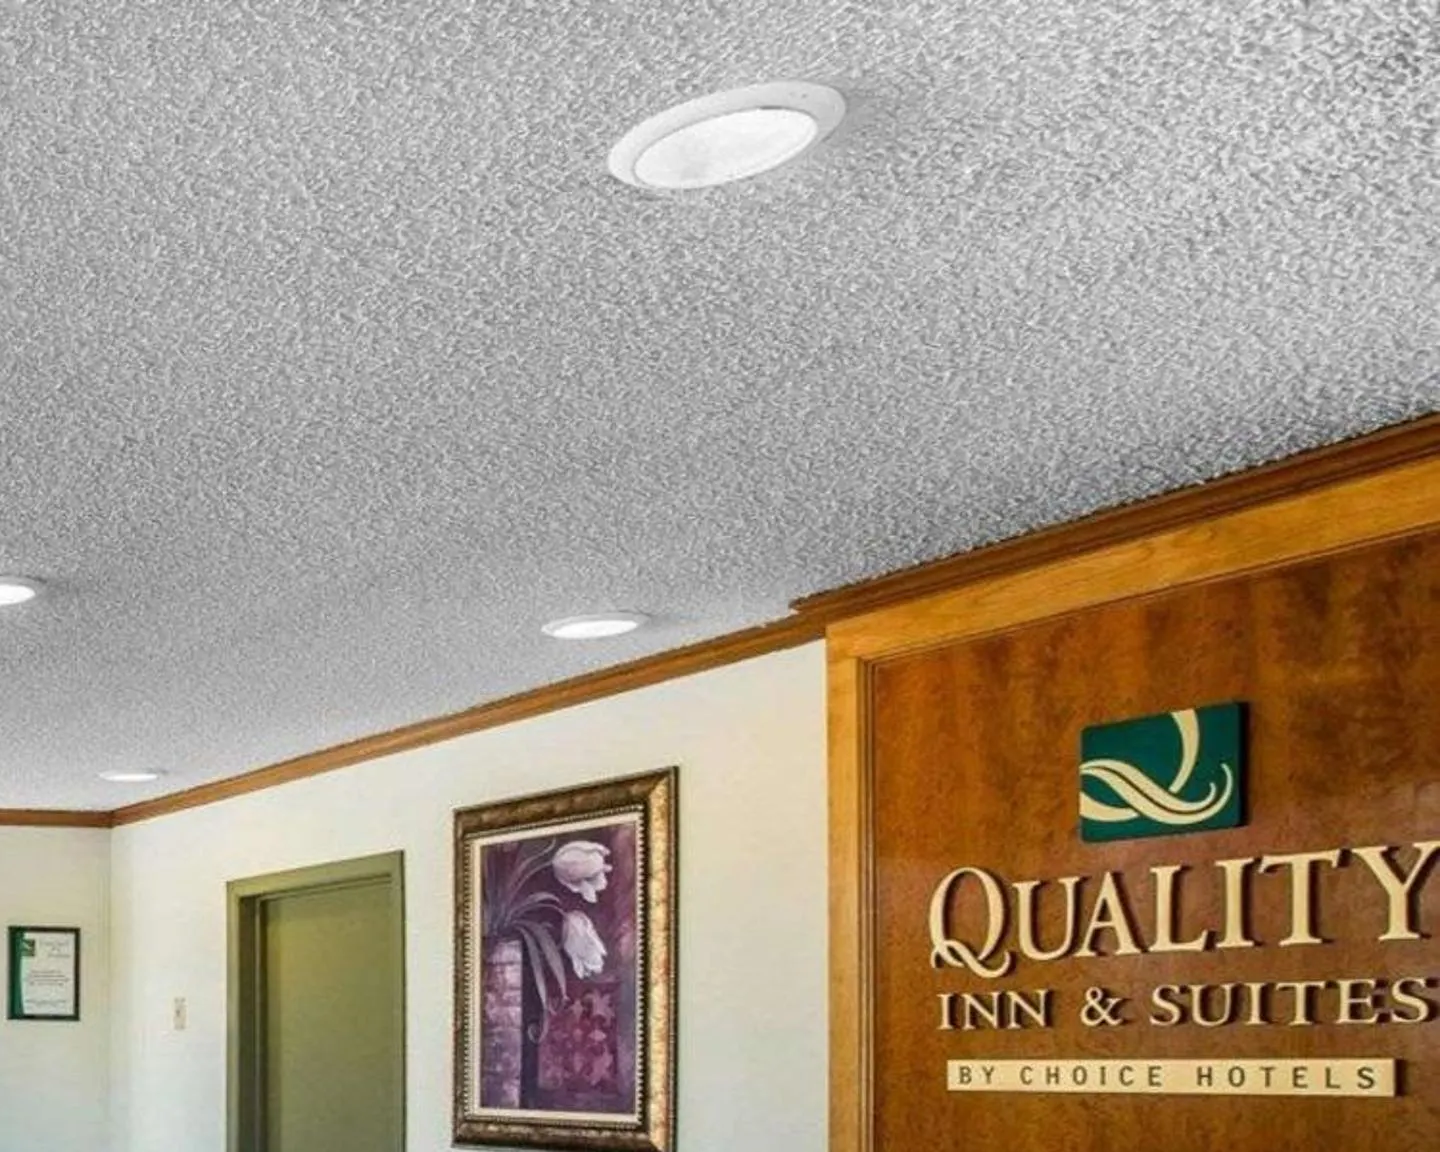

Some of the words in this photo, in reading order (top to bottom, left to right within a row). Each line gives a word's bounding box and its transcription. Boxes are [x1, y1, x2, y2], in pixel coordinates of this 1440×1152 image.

[928, 840, 1440, 978] QUALITY
[937, 988, 1049, 1031] INN
[1079, 985, 1127, 1027] &
[1149, 977, 1431, 1028] SUITES
[958, 1065, 995, 1085] BY
[1019, 1064, 1164, 1088] CHOICE
[1196, 1065, 1377, 1091] HOTELS
